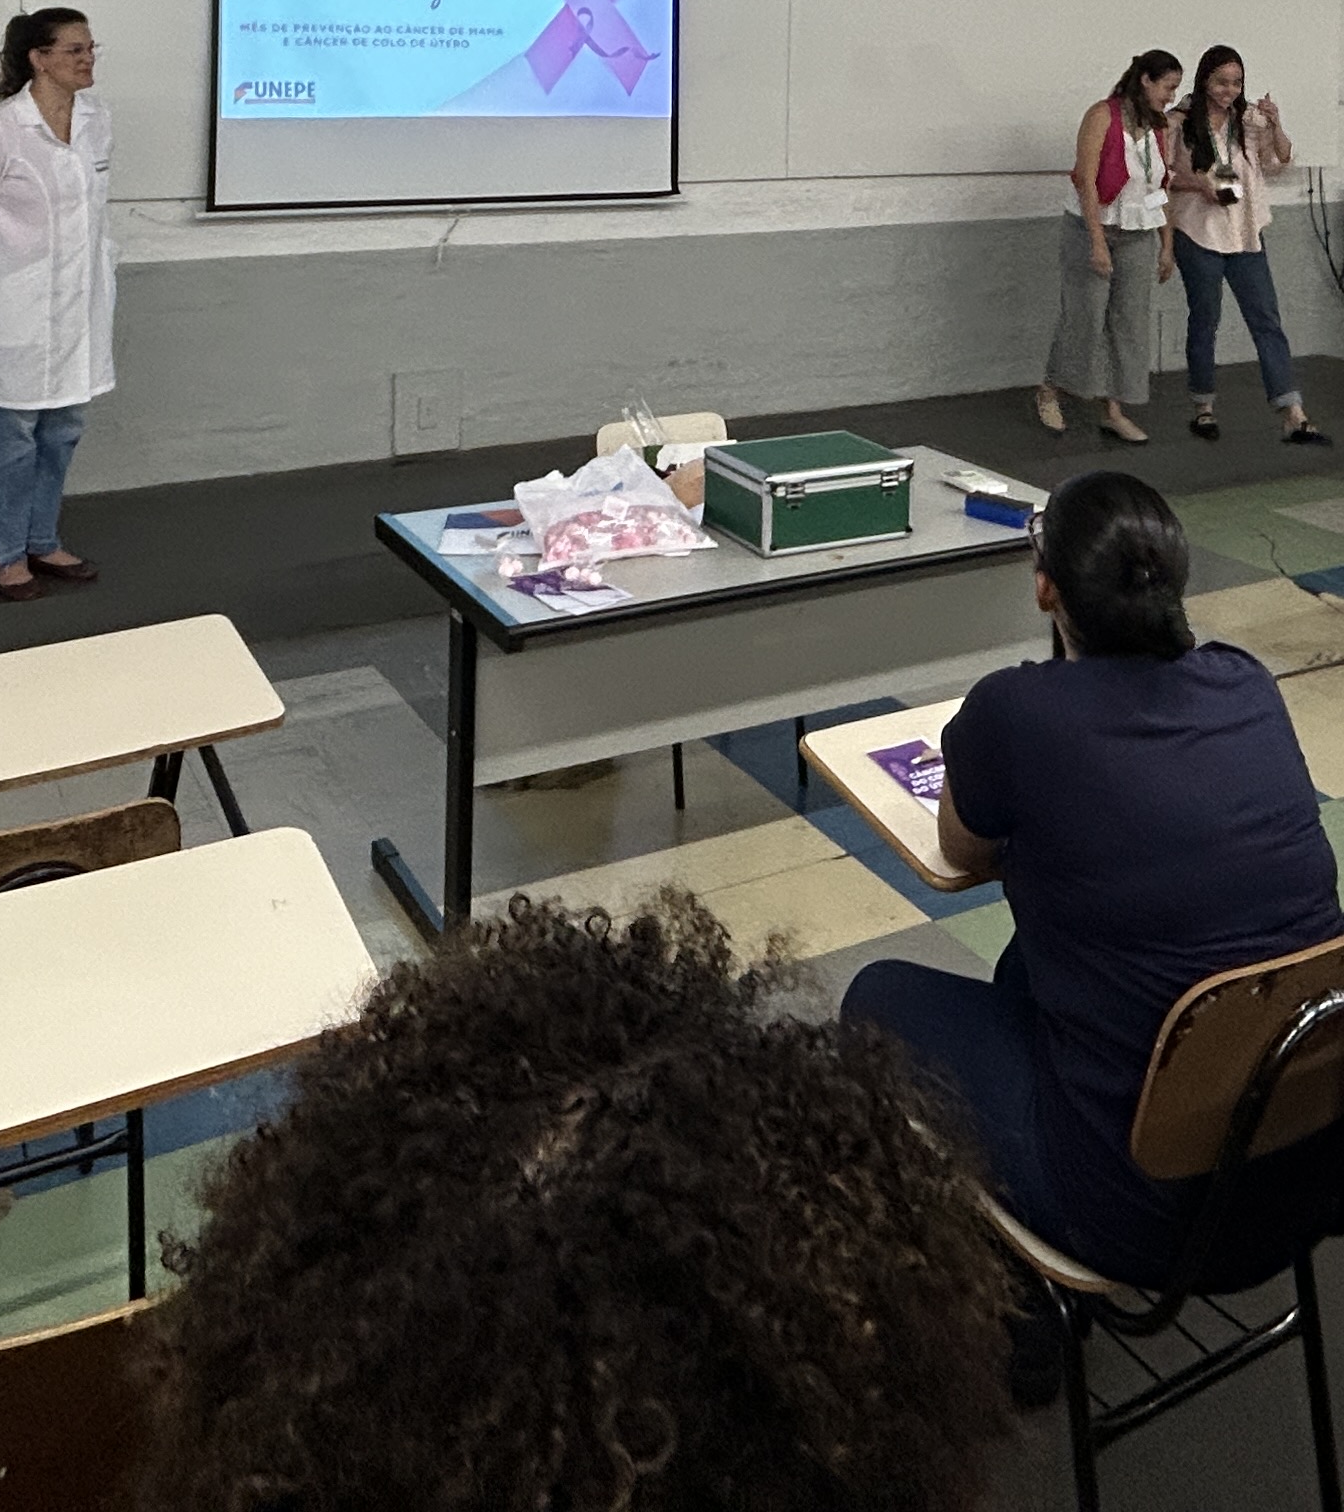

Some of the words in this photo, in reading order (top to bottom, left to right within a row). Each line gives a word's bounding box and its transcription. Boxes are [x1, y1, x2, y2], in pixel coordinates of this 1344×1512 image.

[271, 23, 288, 33] DE
[374, 25, 392, 35] AO
[448, 26, 465, 36] DE
[352, 37, 369, 48] DE
[372, 37, 407, 48] COLO
[410, 38, 426, 48] DE
